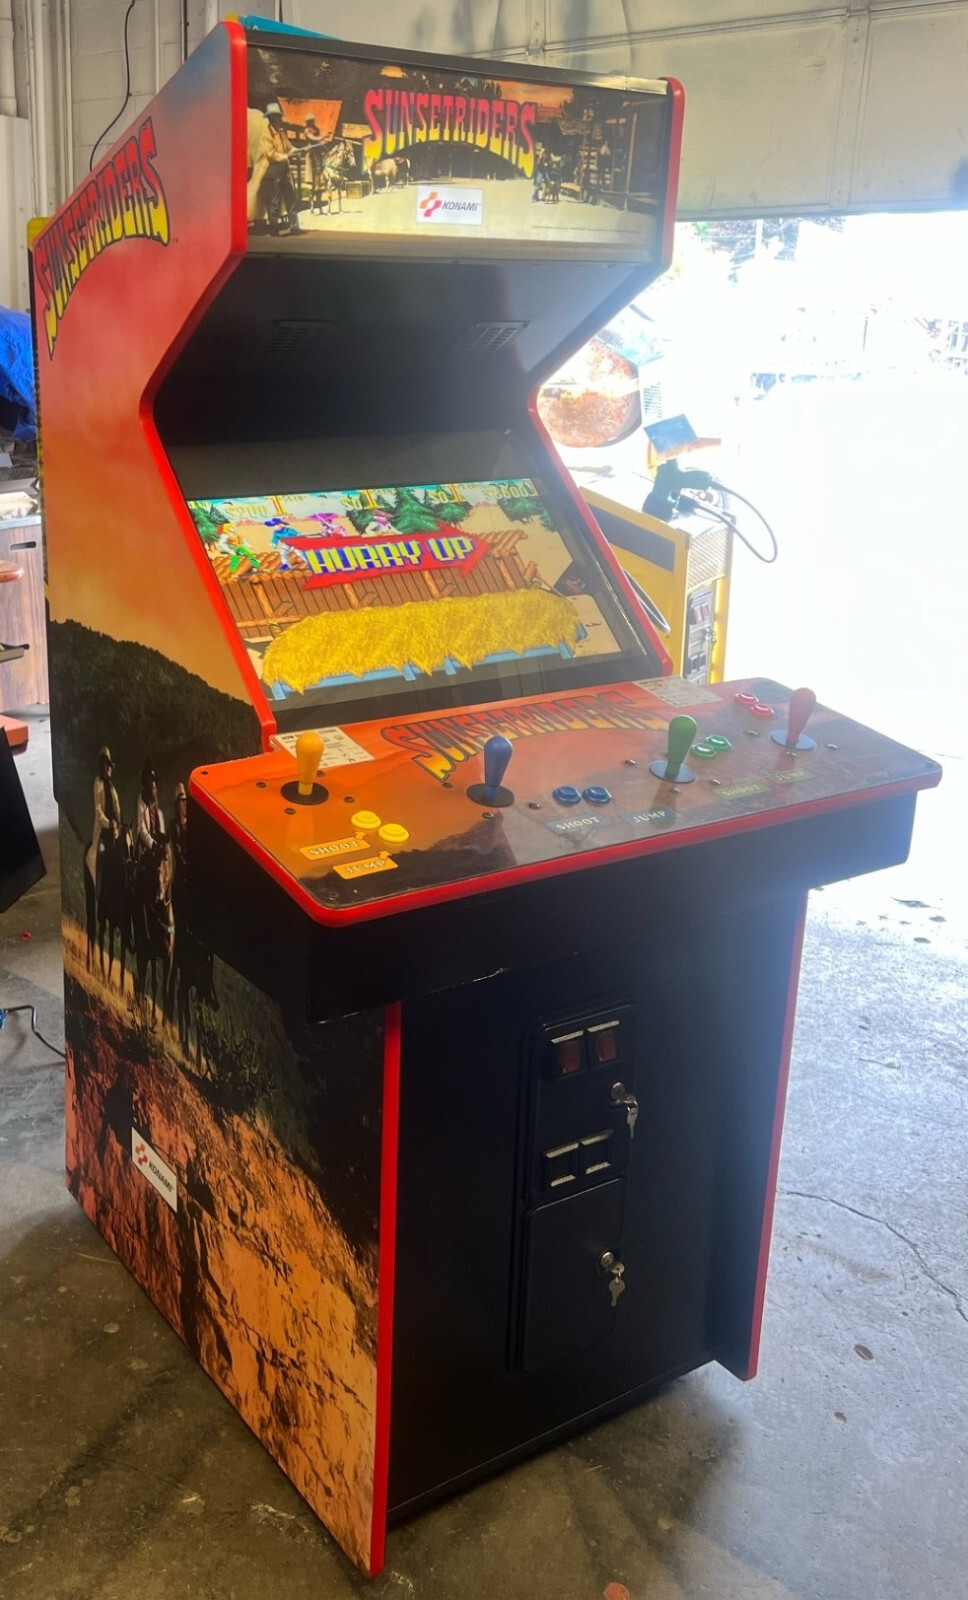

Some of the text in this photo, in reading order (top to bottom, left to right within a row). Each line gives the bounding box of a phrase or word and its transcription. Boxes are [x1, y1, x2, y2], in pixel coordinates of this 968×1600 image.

[442, 201, 479, 212] KONAMI
[304, 536, 475, 575] HURRY UP
[775, 771, 804, 781] JUMP
[721, 784, 760, 797] SHOOT
[556, 816, 601, 831] SHOOT
[632, 809, 667, 823] JUMP
[309, 840, 360, 856] SHOOT
[346, 860, 386, 875] JUMP
[148, 1161, 173, 1192] KONAMI
